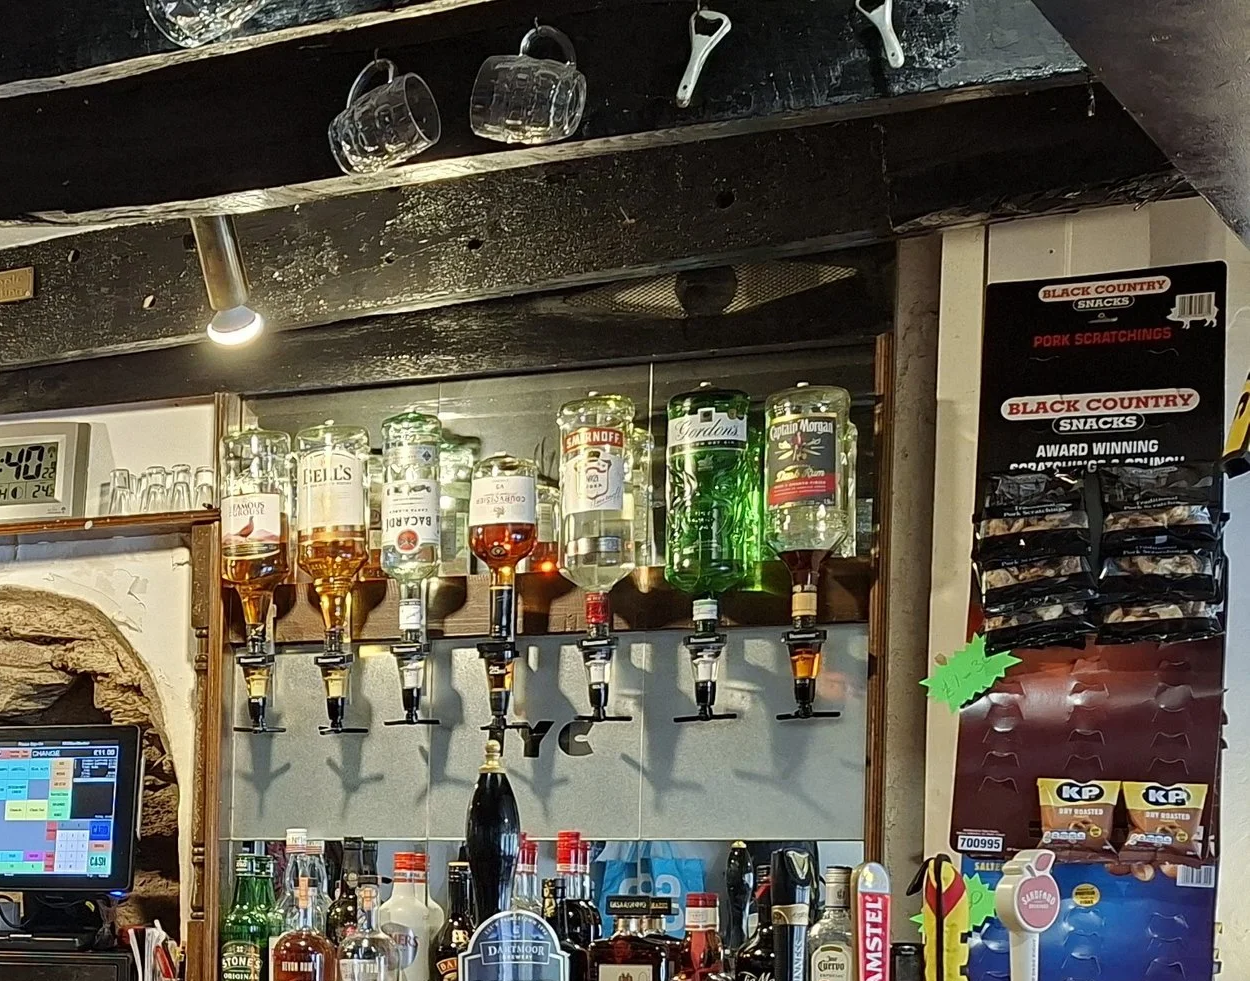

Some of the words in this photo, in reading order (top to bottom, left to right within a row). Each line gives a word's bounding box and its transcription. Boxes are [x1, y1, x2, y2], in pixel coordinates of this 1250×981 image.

[1042, 285, 1090, 300] BLACK
[1094, 279, 1167, 296] COUNTRY
[1076, 297, 1130, 309] SNACKS
[1033, 334, 1071, 348] PORK
[1074, 327, 1172, 346] SCRATCHINGS
[1007, 399, 1080, 416] BLACK
[1086, 393, 1194, 412] COUNTRY
[674, 414, 739, 440] Gordon's
[770, 420, 798, 441] Captain
[799, 418, 833, 435] Morgan
[1058, 416, 1138, 431] SNACKS
[1036, 443, 1088, 458] AWARD
[1092, 440, 1159, 456] WINNING
[231, 508, 265, 517] GROUSE
[232, 502, 265, 511] FAMOUS
[1061, 785, 1100, 800] KP
[1148, 788, 1188, 804] KP
[1058, 807, 1073, 815] DRY
[1073, 808, 1103, 816] ROASTED
[1160, 811, 1191, 820] ROASTED
[959, 837, 1001, 850] 700995
[488, 945, 544, 957] DARTMOOR
[221, 955, 262, 971] STONE'S
[818, 959, 845, 972] Cuervo
